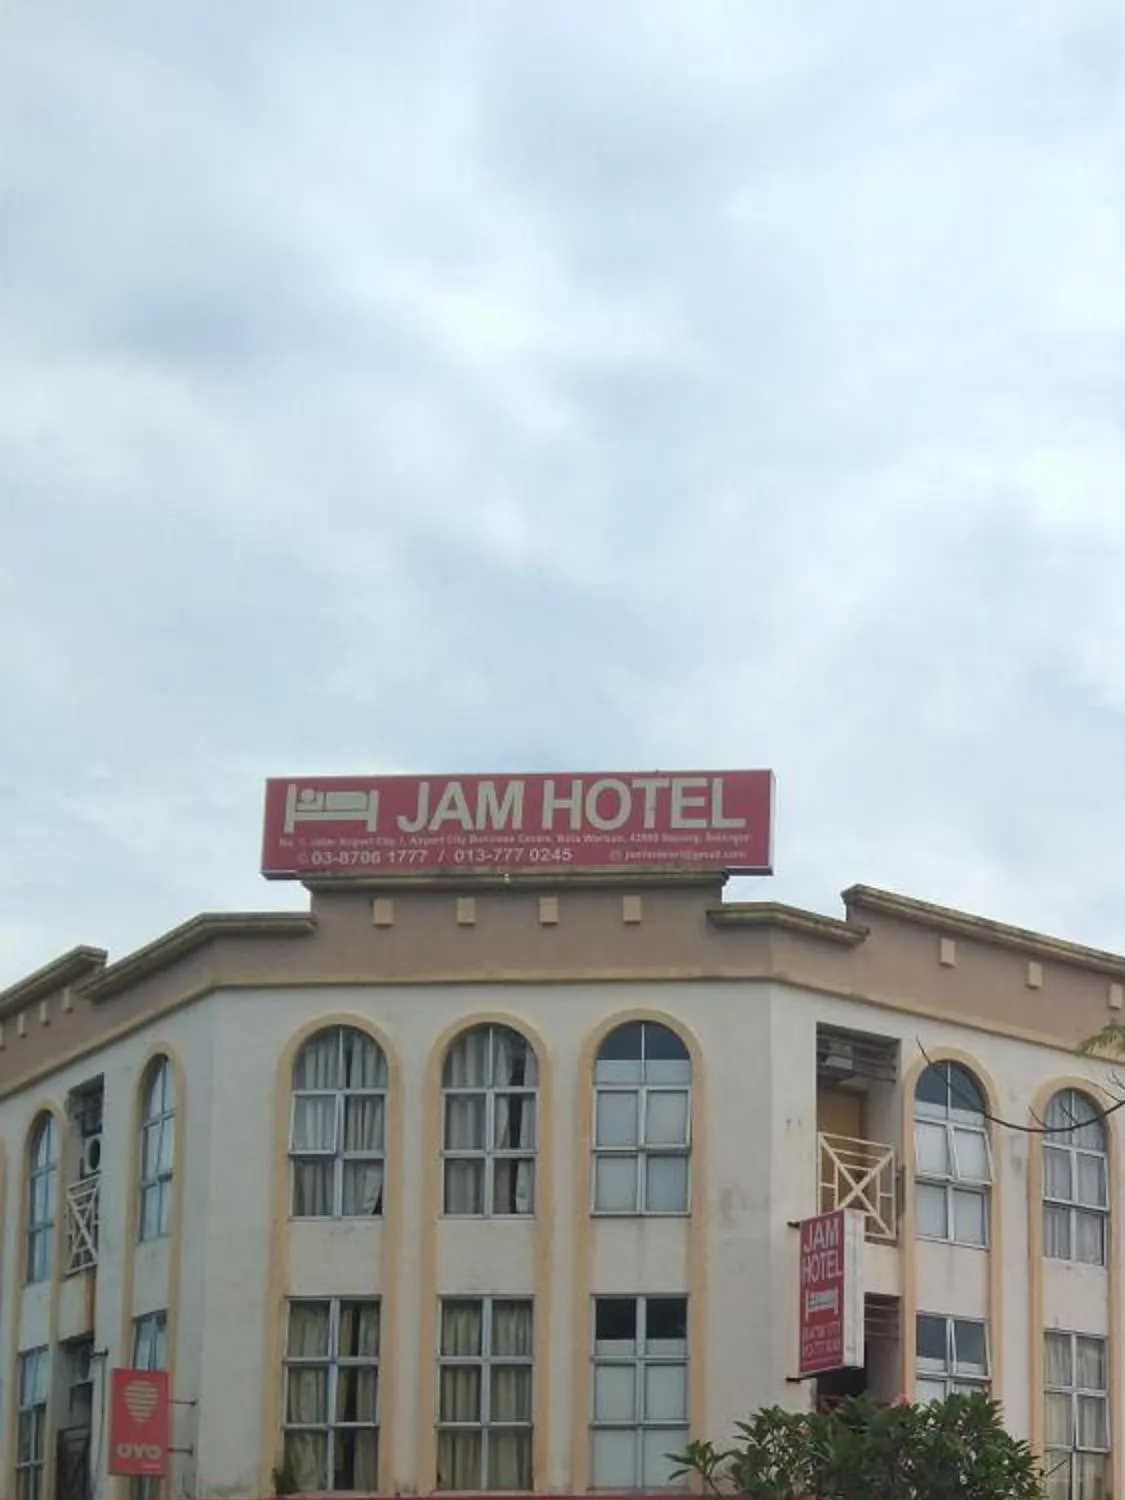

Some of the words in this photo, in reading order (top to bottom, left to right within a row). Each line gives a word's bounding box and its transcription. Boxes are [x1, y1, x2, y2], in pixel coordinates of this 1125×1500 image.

[397, 780, 526, 833] JAM
[541, 777, 747, 832] HOTEL
[803, 1217, 839, 1252] JAM
[802, 1249, 842, 1284] HOTEL
[116, 1442, 161, 1459] OYO
